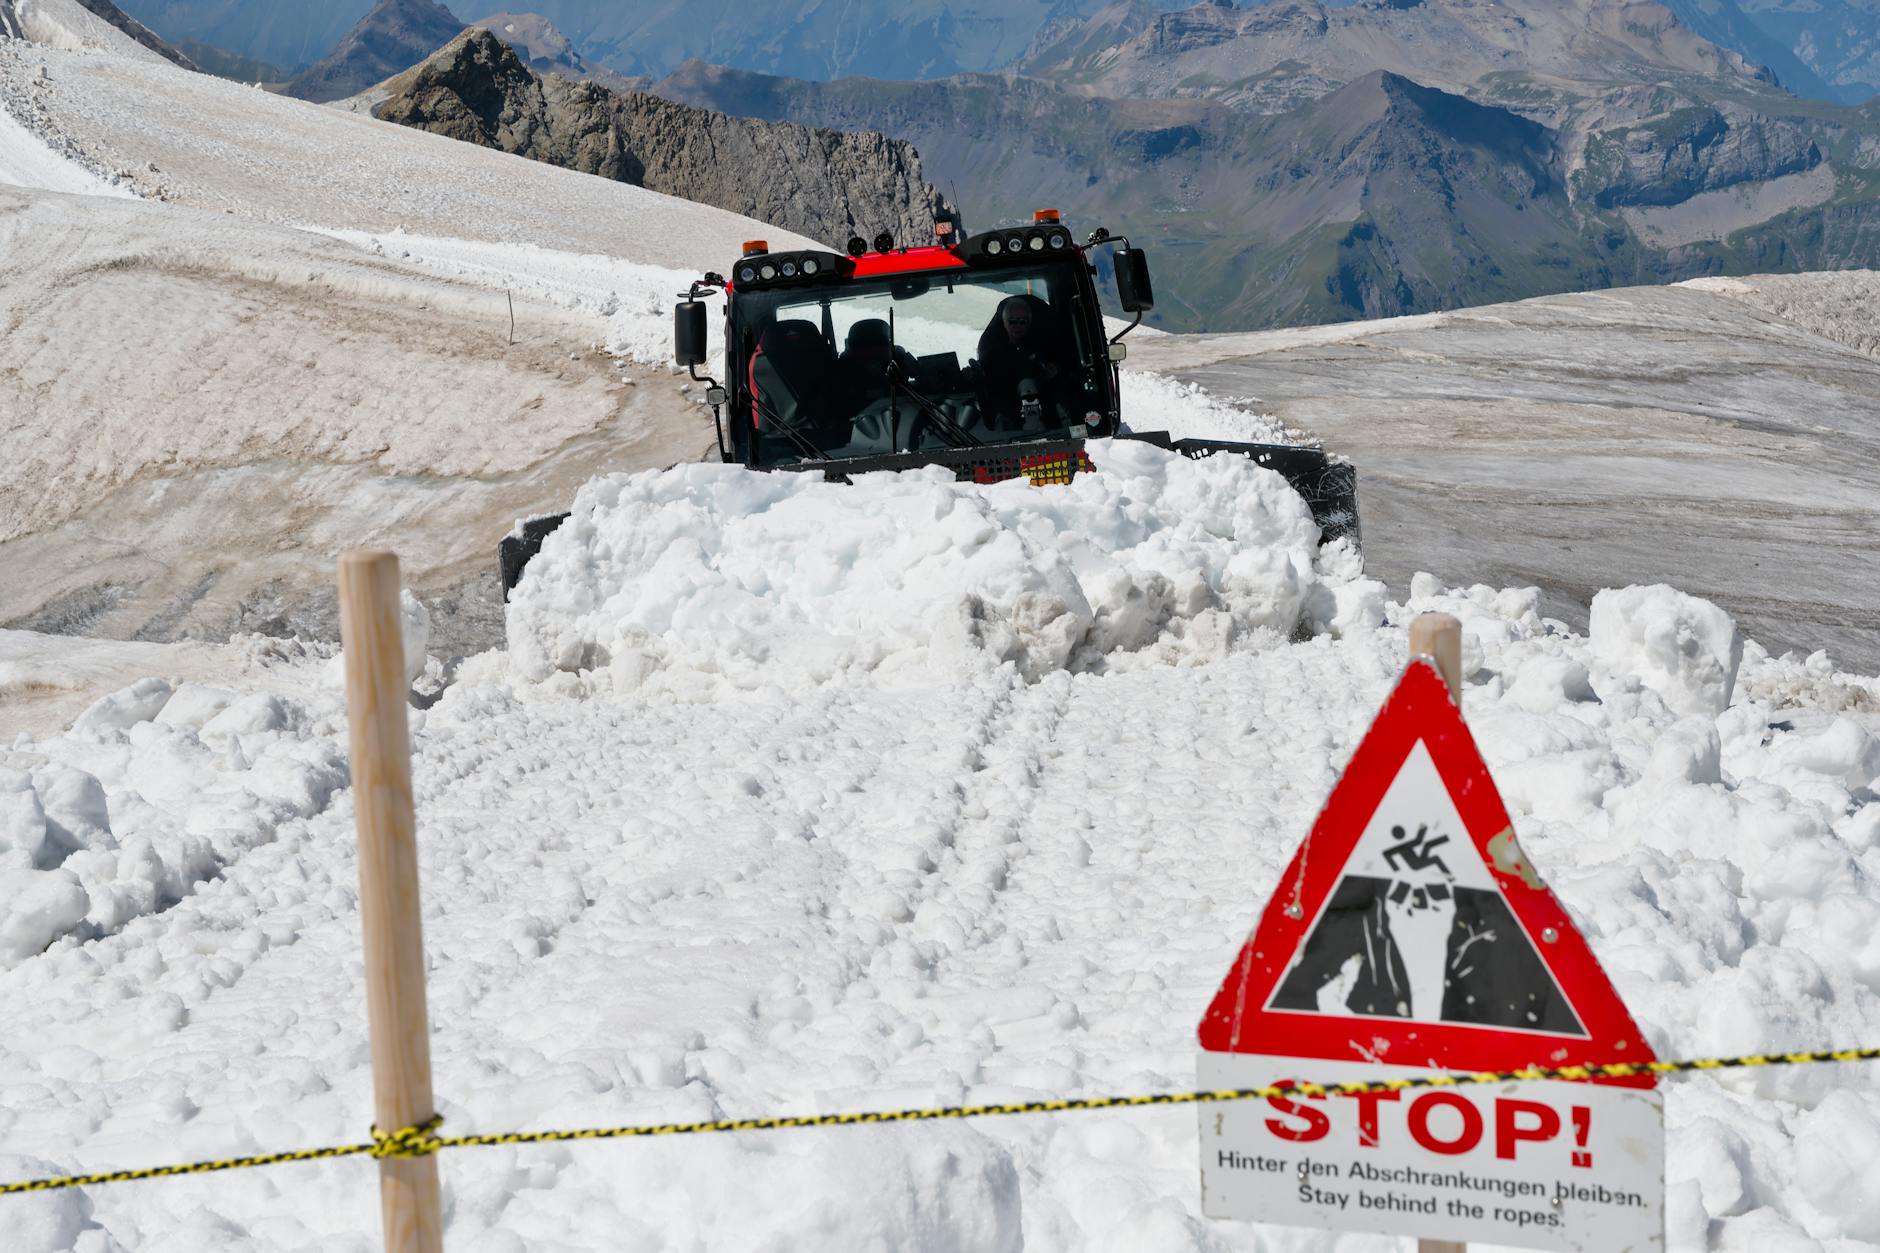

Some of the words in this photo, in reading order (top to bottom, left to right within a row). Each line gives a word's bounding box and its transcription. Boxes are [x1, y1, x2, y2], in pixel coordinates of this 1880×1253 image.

[1264, 1078, 1593, 1168] STOP!
[1217, 1149, 1287, 1174] Hinter
[1297, 1157, 1339, 1178] den
[1348, 1160, 1546, 1198] Abschrankungen
[1555, 1180, 1648, 1208] bleiben.
[1298, 1183, 1349, 1210] Stay
[1358, 1189, 1437, 1215] behind
[1446, 1197, 1485, 1220] the
[1493, 1205, 1566, 1228] ropes.
